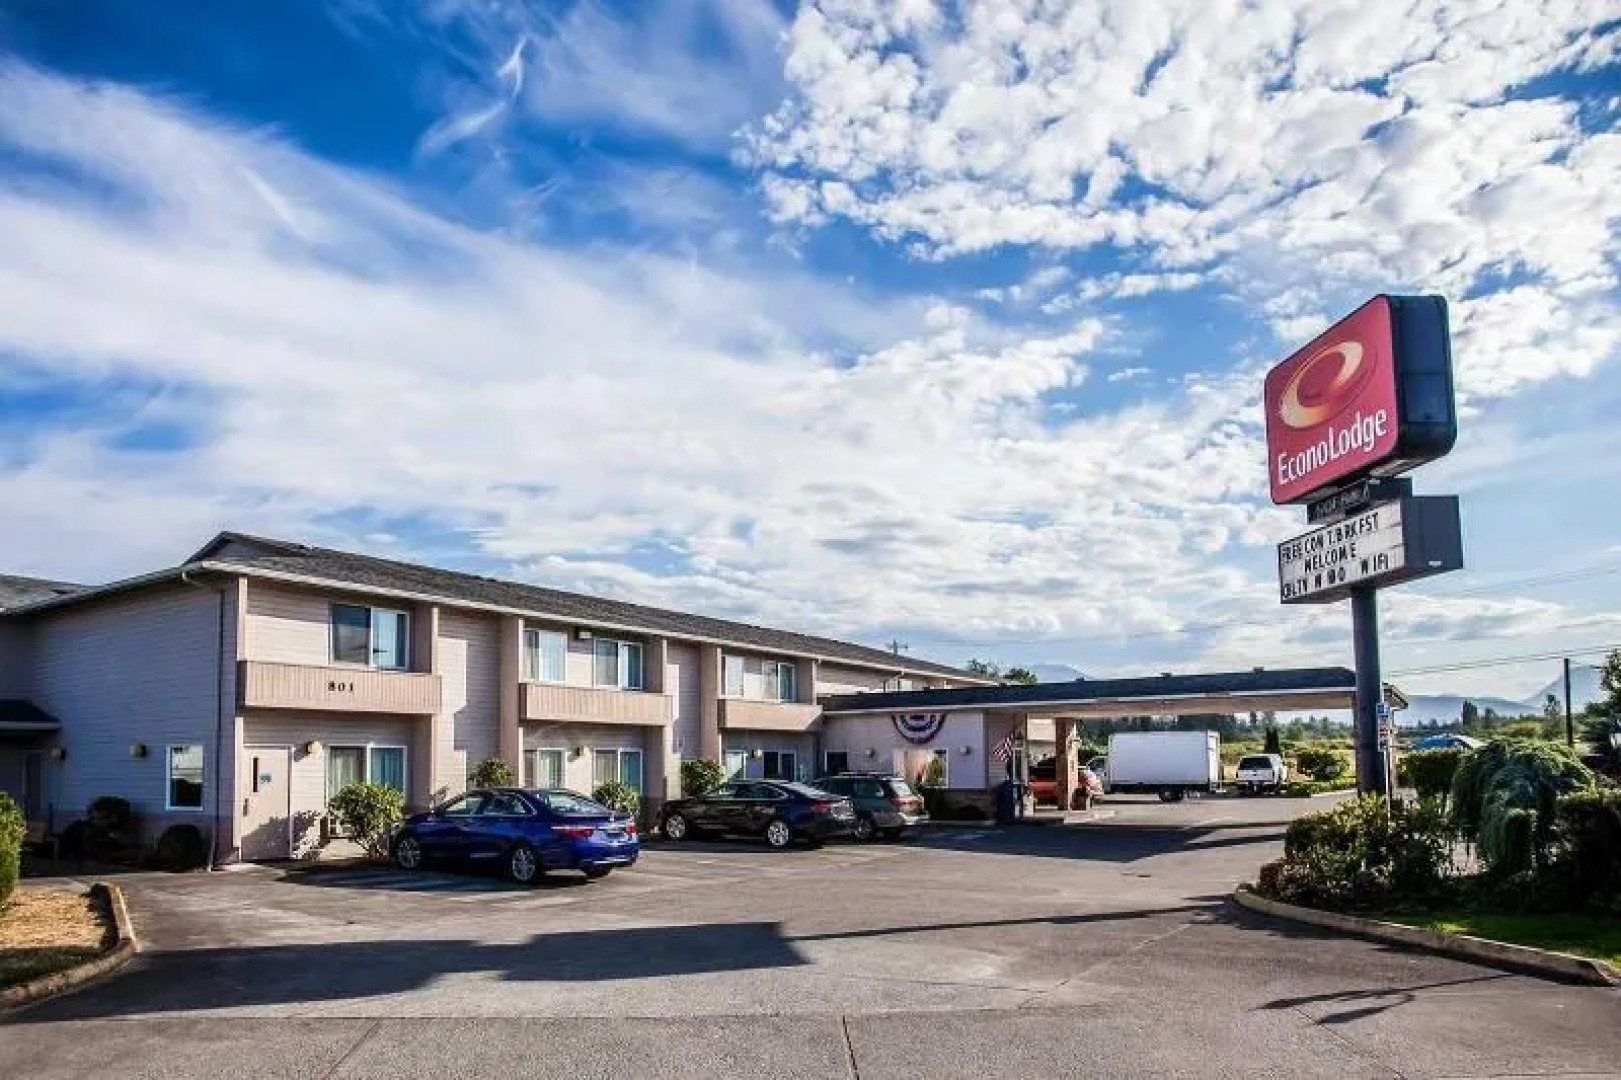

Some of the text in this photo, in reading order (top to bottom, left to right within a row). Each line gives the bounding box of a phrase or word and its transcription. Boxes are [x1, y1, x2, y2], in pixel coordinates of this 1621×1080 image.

[1278, 408, 1387, 485] EconoLodge
[1281, 541, 1303, 564] FREE
[1304, 541, 1357, 573] WELCOME
[327, 680, 354, 692] 801
